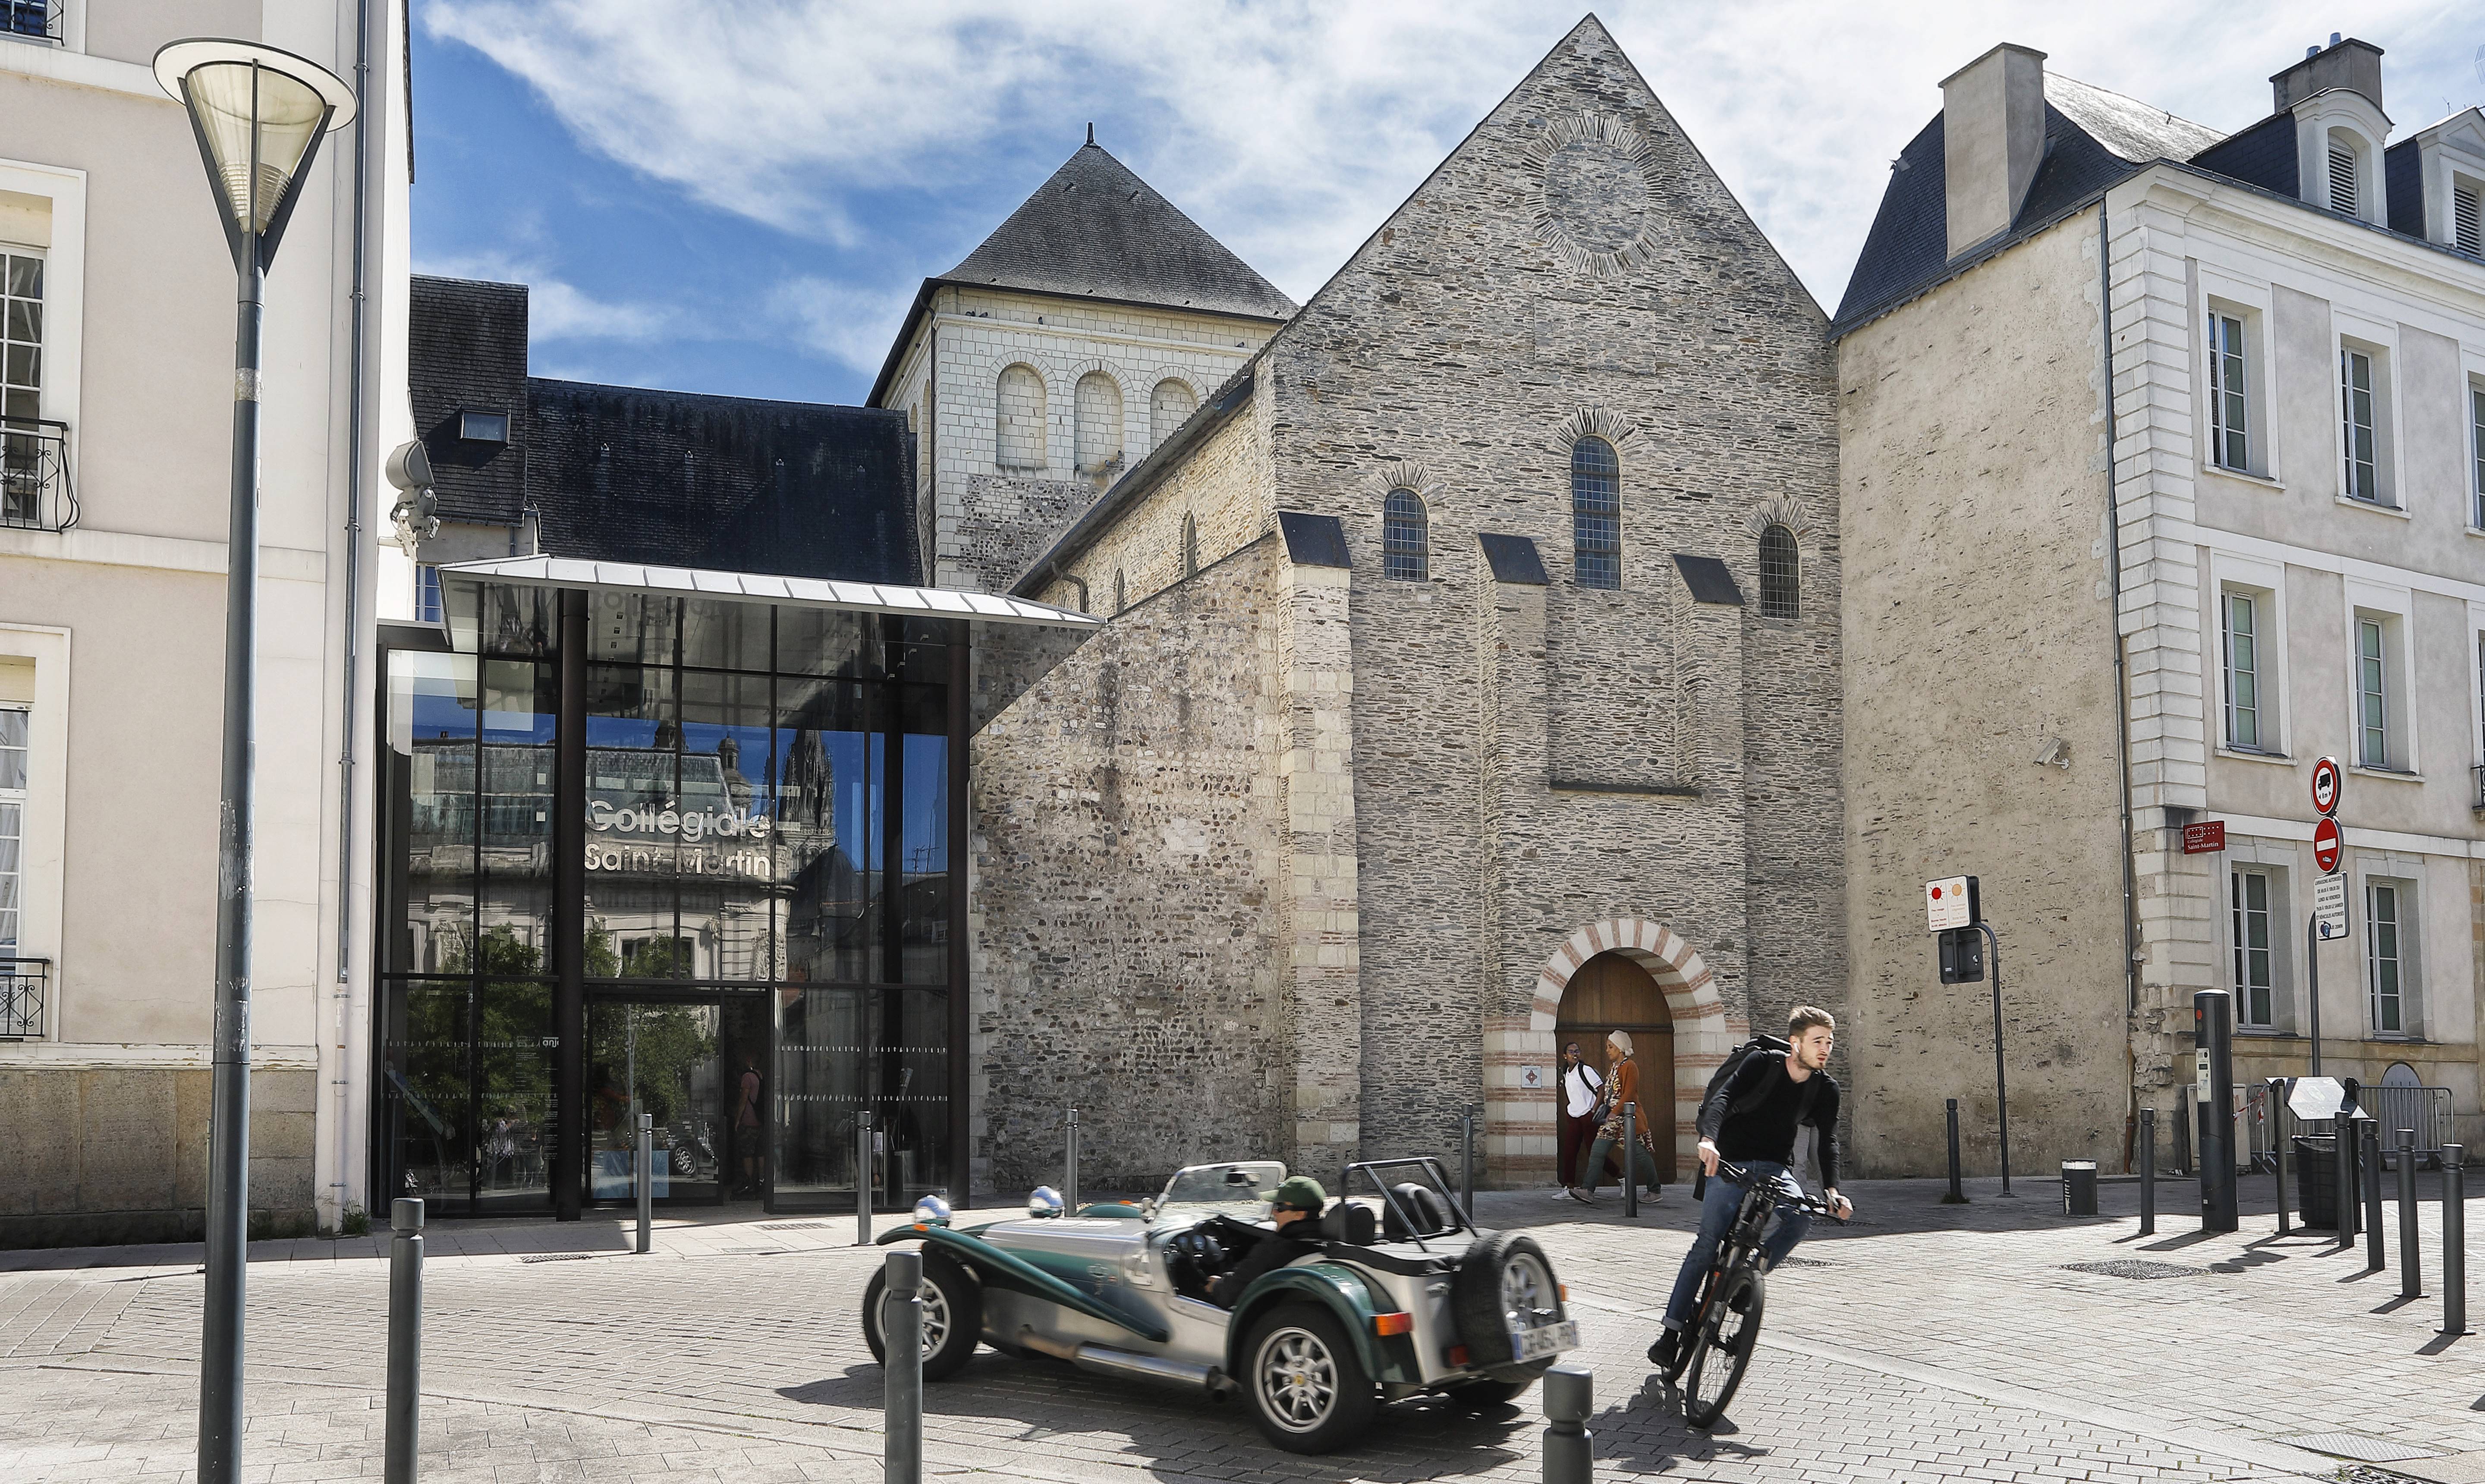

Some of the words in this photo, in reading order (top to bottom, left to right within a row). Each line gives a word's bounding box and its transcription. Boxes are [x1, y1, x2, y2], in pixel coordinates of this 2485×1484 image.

[585, 799, 771, 843] Collégiale
[585, 843, 771, 877] Saint-Martin
[2188, 841, 2219, 850] Saint-Martin
